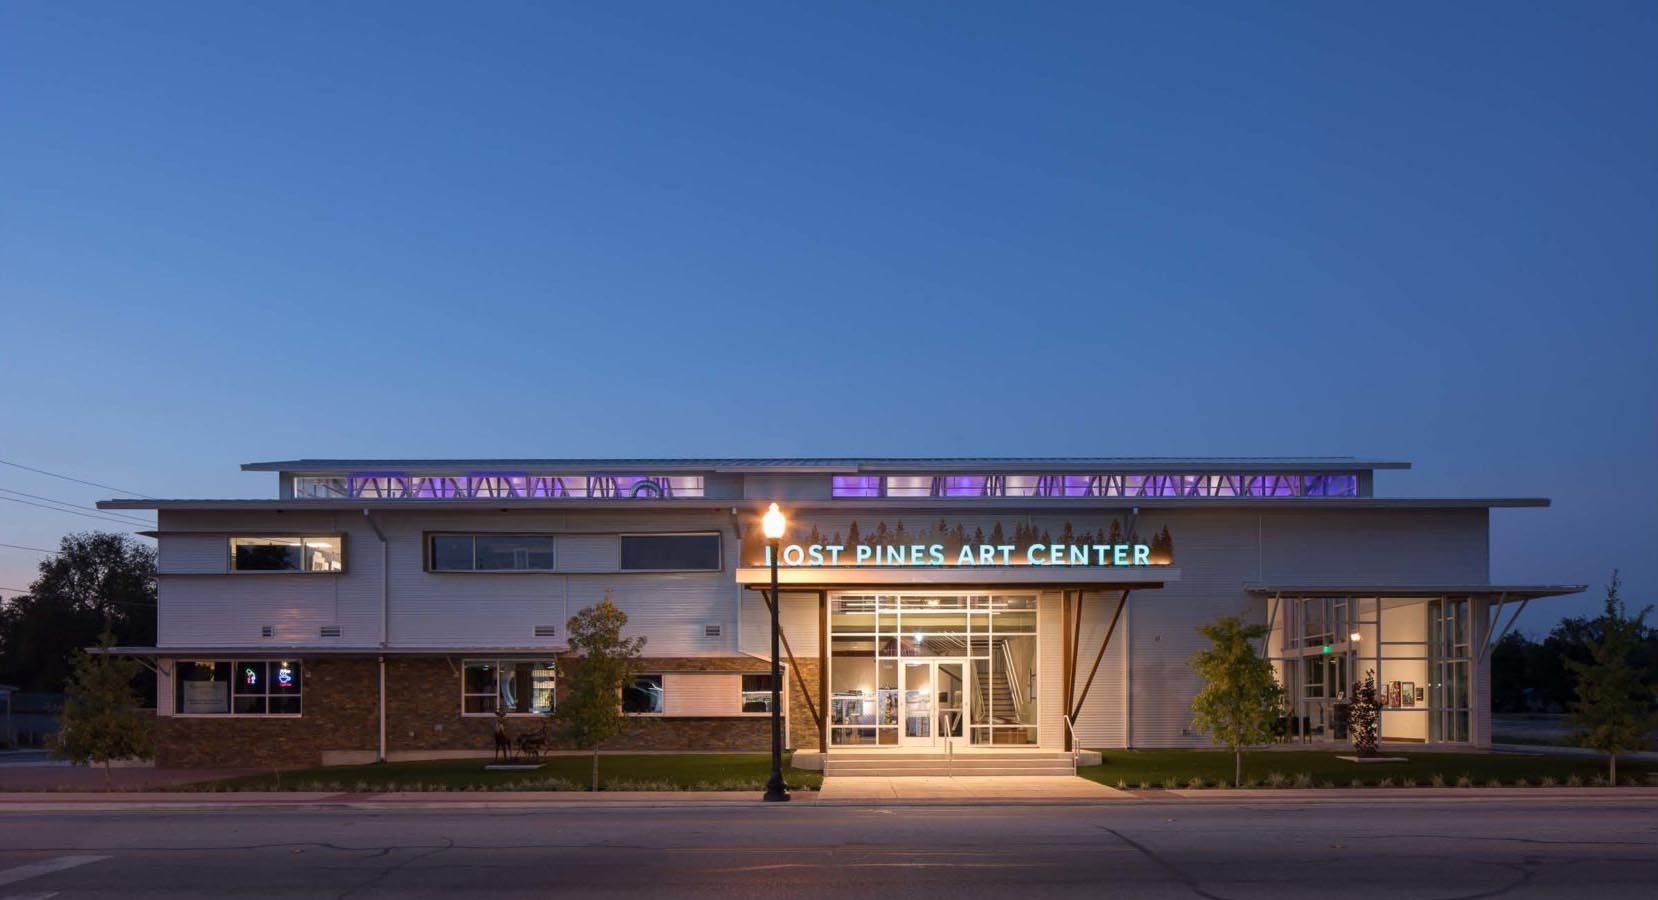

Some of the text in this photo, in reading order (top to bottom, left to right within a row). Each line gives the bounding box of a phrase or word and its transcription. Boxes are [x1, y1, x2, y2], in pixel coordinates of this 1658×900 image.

[765, 544, 1150, 566] LOST PINES ART CENTER
